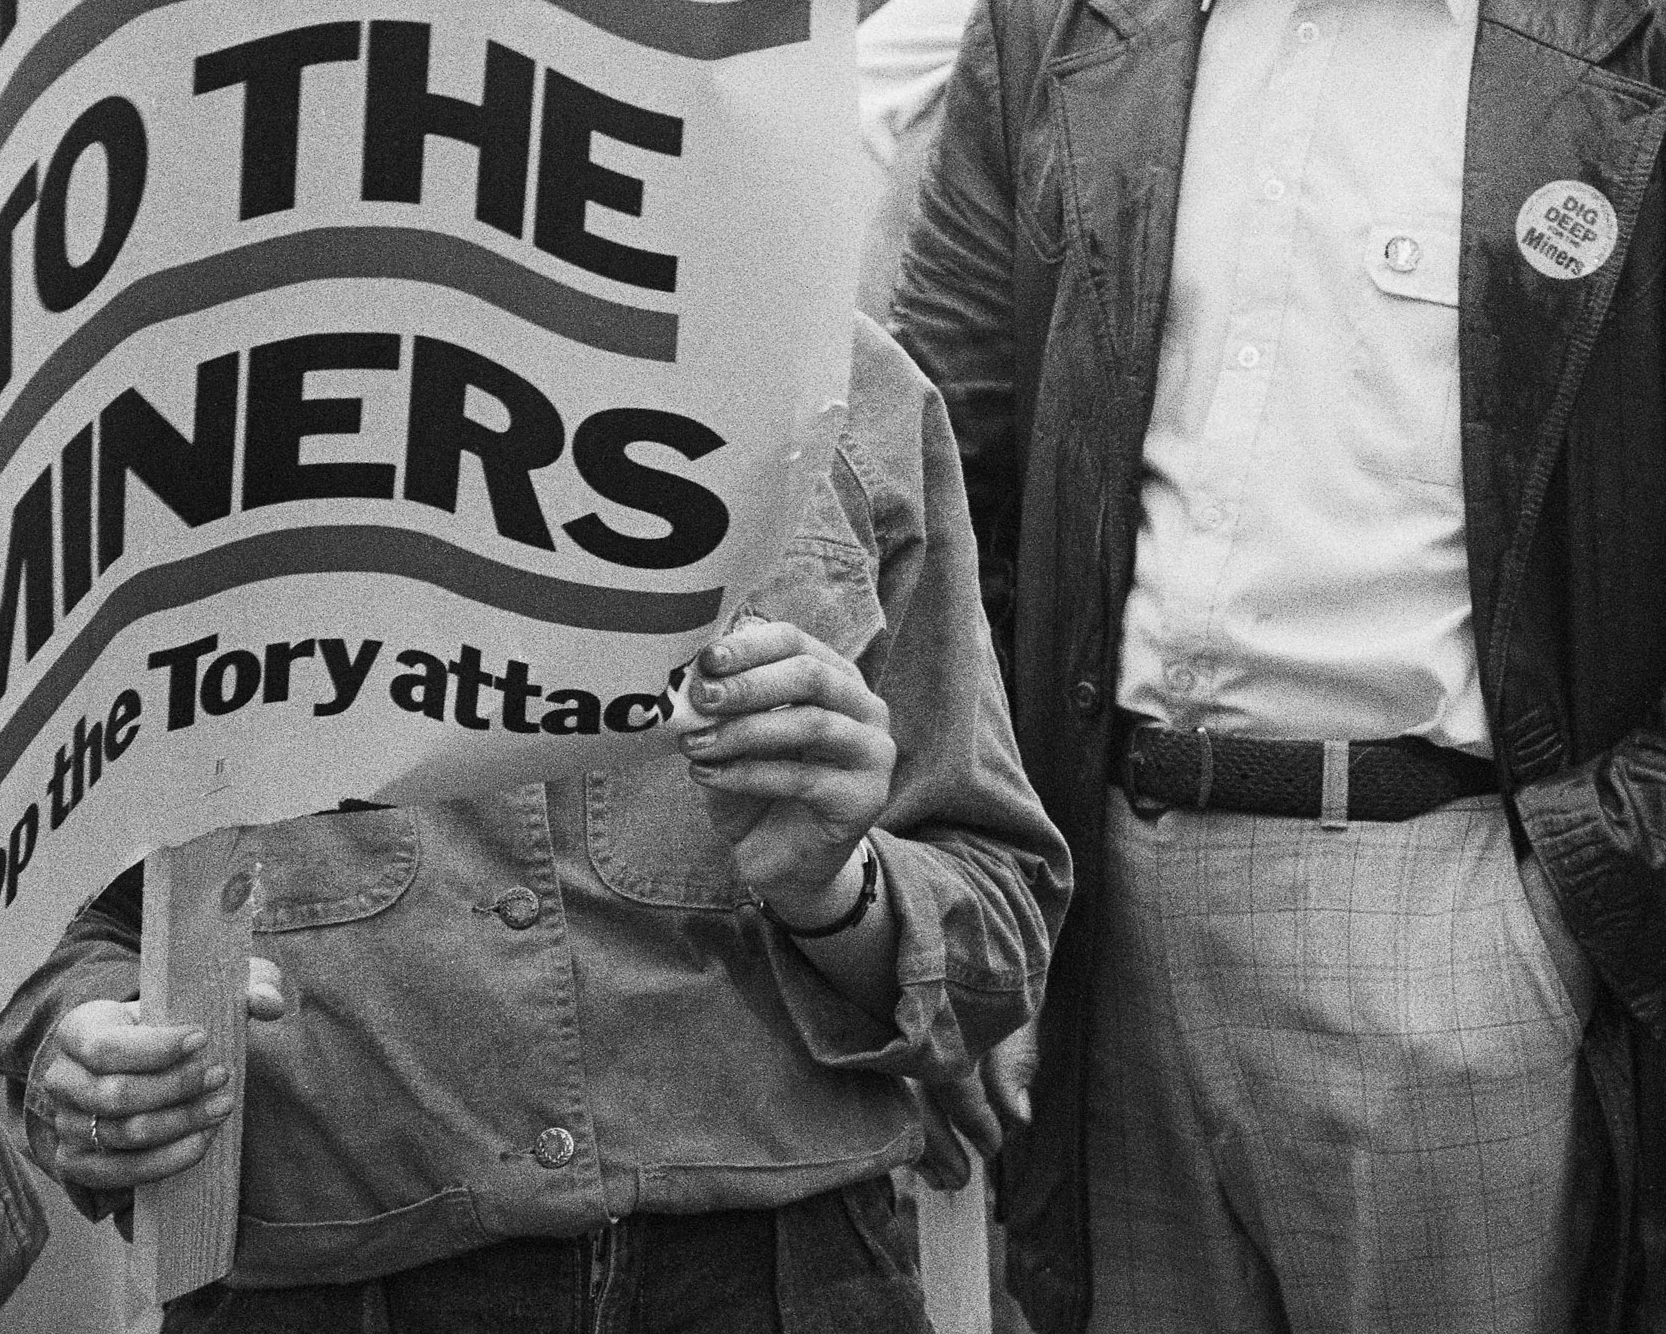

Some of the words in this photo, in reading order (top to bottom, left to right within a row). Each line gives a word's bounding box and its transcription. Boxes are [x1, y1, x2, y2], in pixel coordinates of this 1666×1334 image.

[192, 18, 685, 294] THE
[1545, 206, 1598, 242] DEEP
[1562, 195, 1599, 226] DIG
[1521, 226, 1586, 276] Miners
[46, 688, 142, 831] the
[146, 633, 384, 732] Tory
